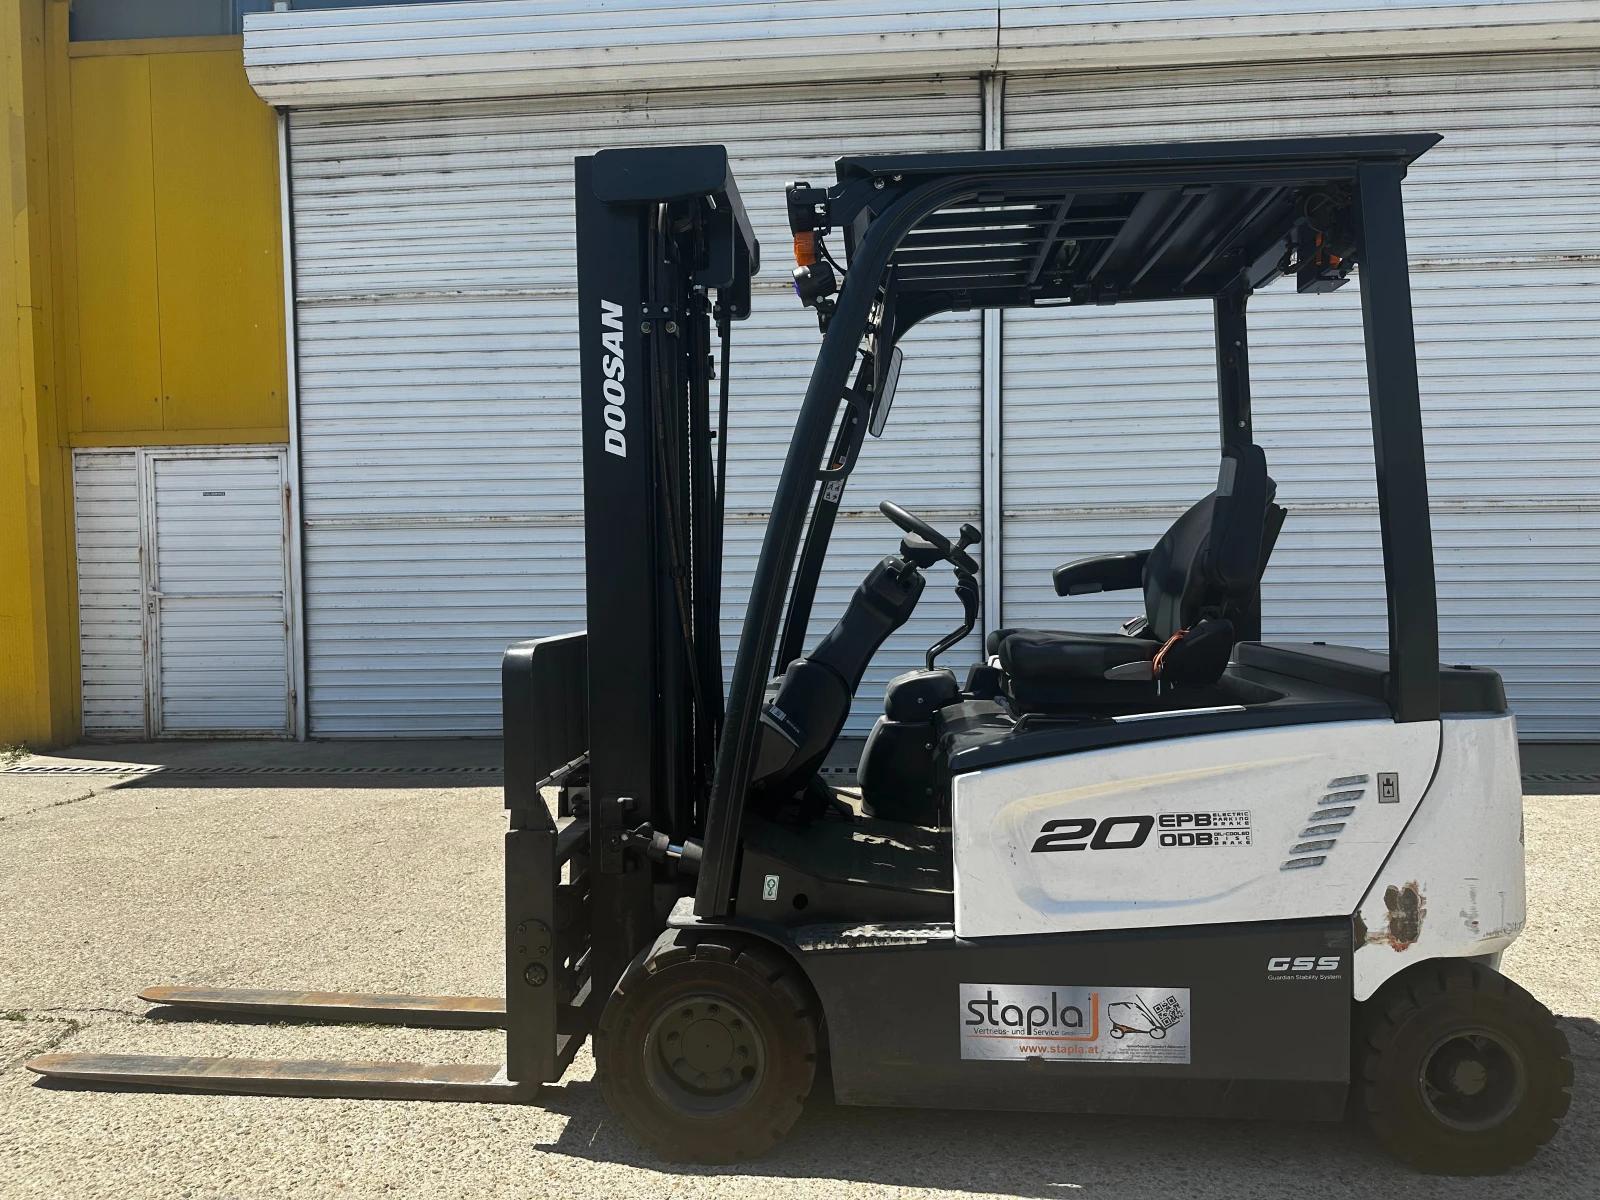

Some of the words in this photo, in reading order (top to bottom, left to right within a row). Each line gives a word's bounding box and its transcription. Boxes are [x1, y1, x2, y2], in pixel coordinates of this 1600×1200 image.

[601, 299, 627, 458] DOOSAN
[1158, 813, 1212, 827] EPB
[1031, 815, 1155, 853] 20
[1159, 832, 1213, 847] ODB
[1267, 956, 1341, 971] GSS
[1320, 973, 1342, 981] System
[973, 1027, 1010, 1035] Vertriebs-
[1011, 1028, 1025, 1036] und
[1033, 1028, 1060, 1036] Service
[1019, 1045, 1099, 1056] www.stapla.at
